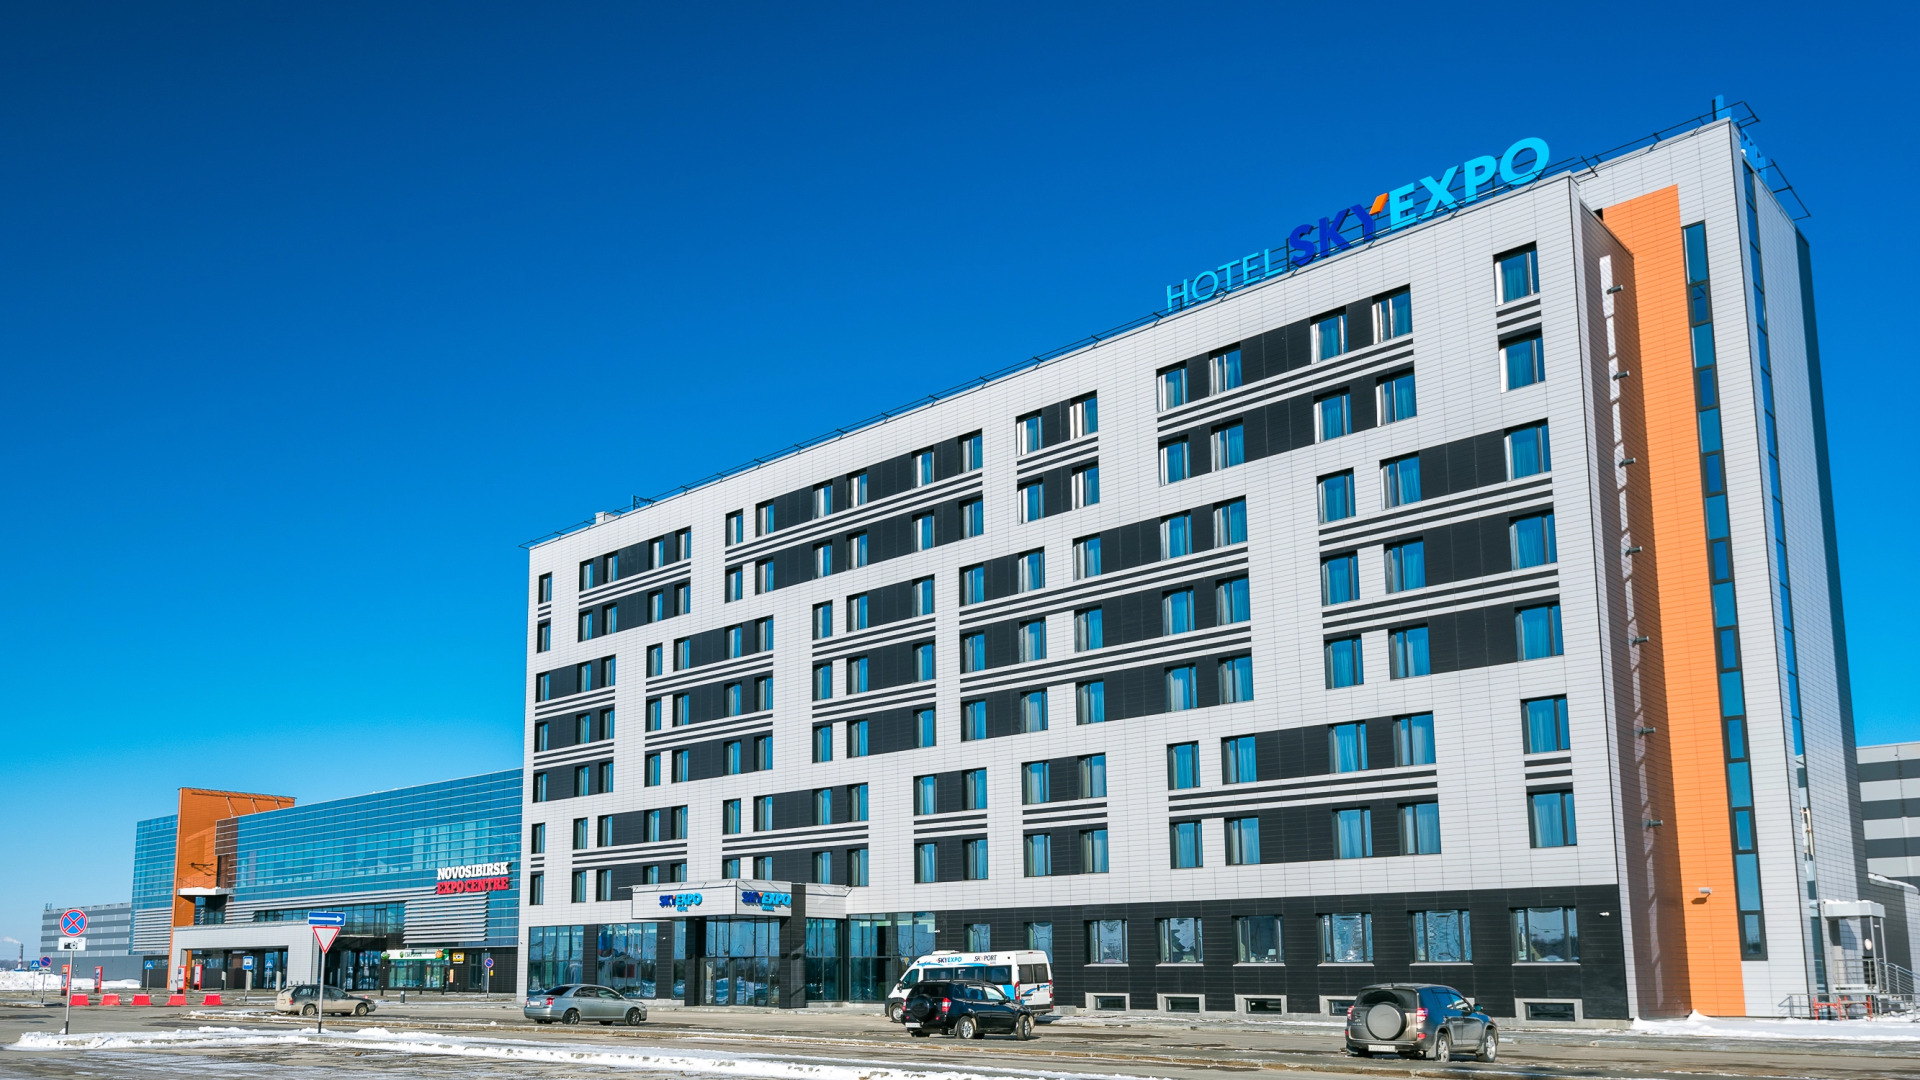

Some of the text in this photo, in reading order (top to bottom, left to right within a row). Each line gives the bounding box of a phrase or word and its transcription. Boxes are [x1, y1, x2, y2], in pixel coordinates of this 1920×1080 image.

[1166, 248, 1283, 313] HOTEL
[437, 862, 509, 880] NOVOSIBIRSK
[437, 877, 509, 895] EXPO CENTRE
